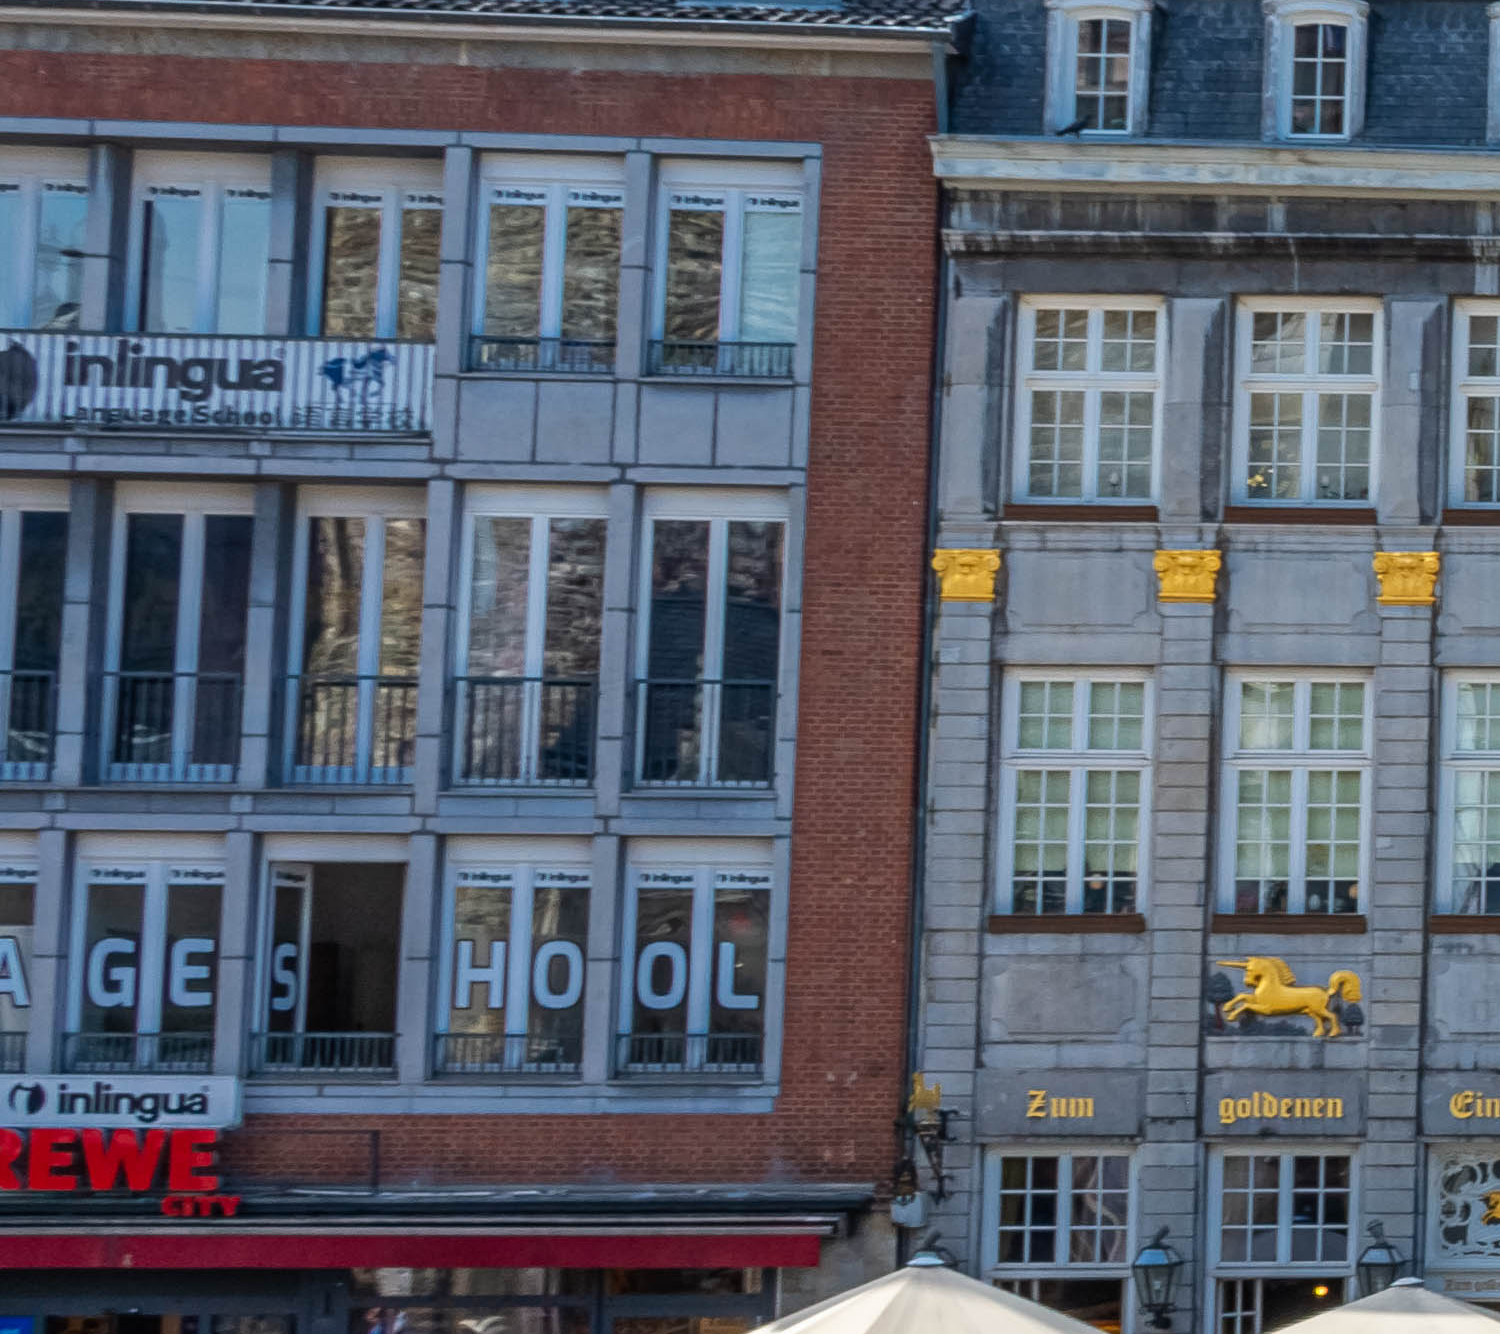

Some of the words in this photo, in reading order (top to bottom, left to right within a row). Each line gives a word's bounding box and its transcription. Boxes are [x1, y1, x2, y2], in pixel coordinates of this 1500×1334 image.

[64, 339, 284, 402] inlingua
[192, 403, 281, 427] School
[57, 1081, 209, 1123] inlingua
[1026, 1090, 1094, 1118] Zum
[1218, 1091, 1344, 1124] goldenen
[161, 1195, 241, 1216] CITY
